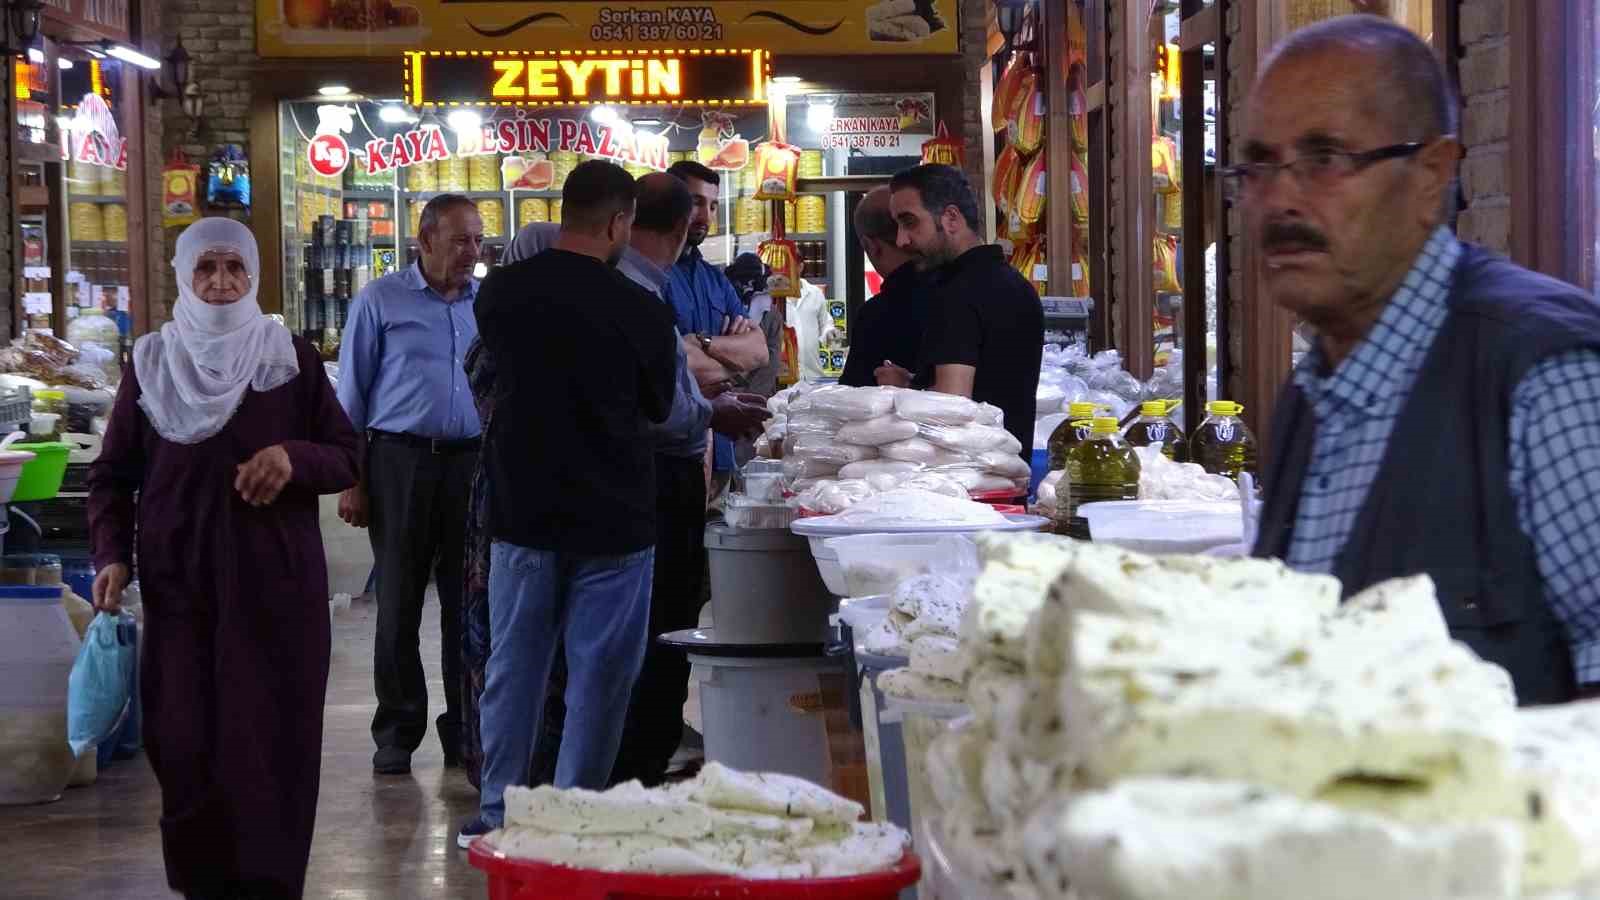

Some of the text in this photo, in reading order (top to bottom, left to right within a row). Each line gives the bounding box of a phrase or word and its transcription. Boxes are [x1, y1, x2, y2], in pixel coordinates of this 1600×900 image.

[600, 8, 715, 23] Serkan KAYA
[591, 26, 723, 40] 0541 387 60 21
[824, 117, 900, 132] ERKAN KAYA
[853, 135, 871, 147] 387
[873, 135, 886, 147] 60
[889, 134, 901, 147] 21
[367, 127, 449, 175] KAYA
